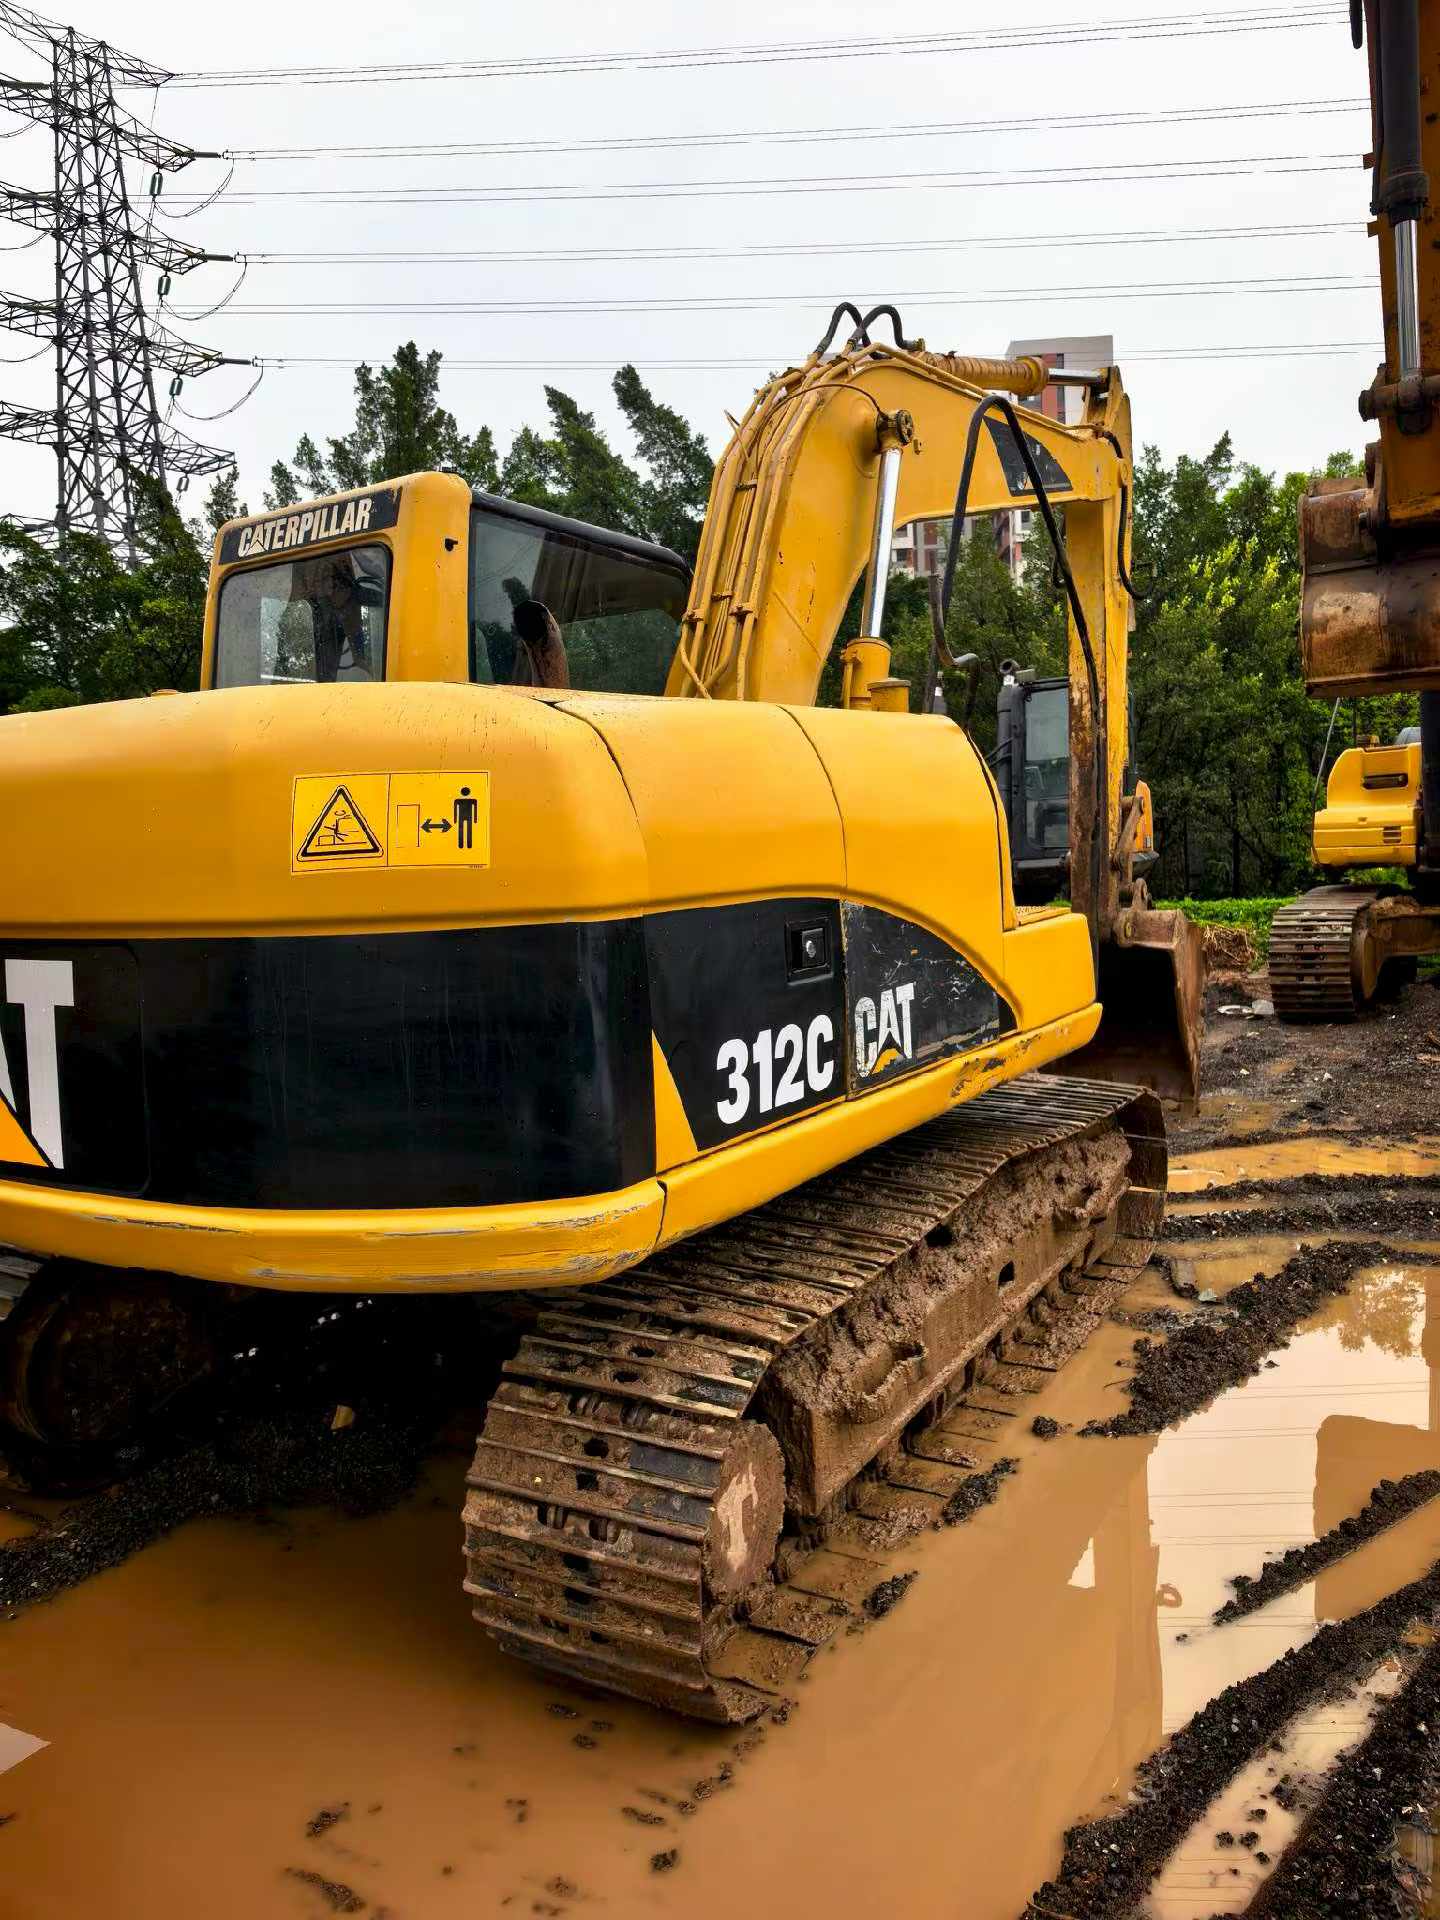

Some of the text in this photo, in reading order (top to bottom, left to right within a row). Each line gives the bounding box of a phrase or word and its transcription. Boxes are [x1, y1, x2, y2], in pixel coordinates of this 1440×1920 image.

[237, 498, 373, 557] CATERPILLAR
[0, 958, 75, 1170] T
[716, 1014, 834, 1125] 312C
[854, 982, 915, 1079] CAT
